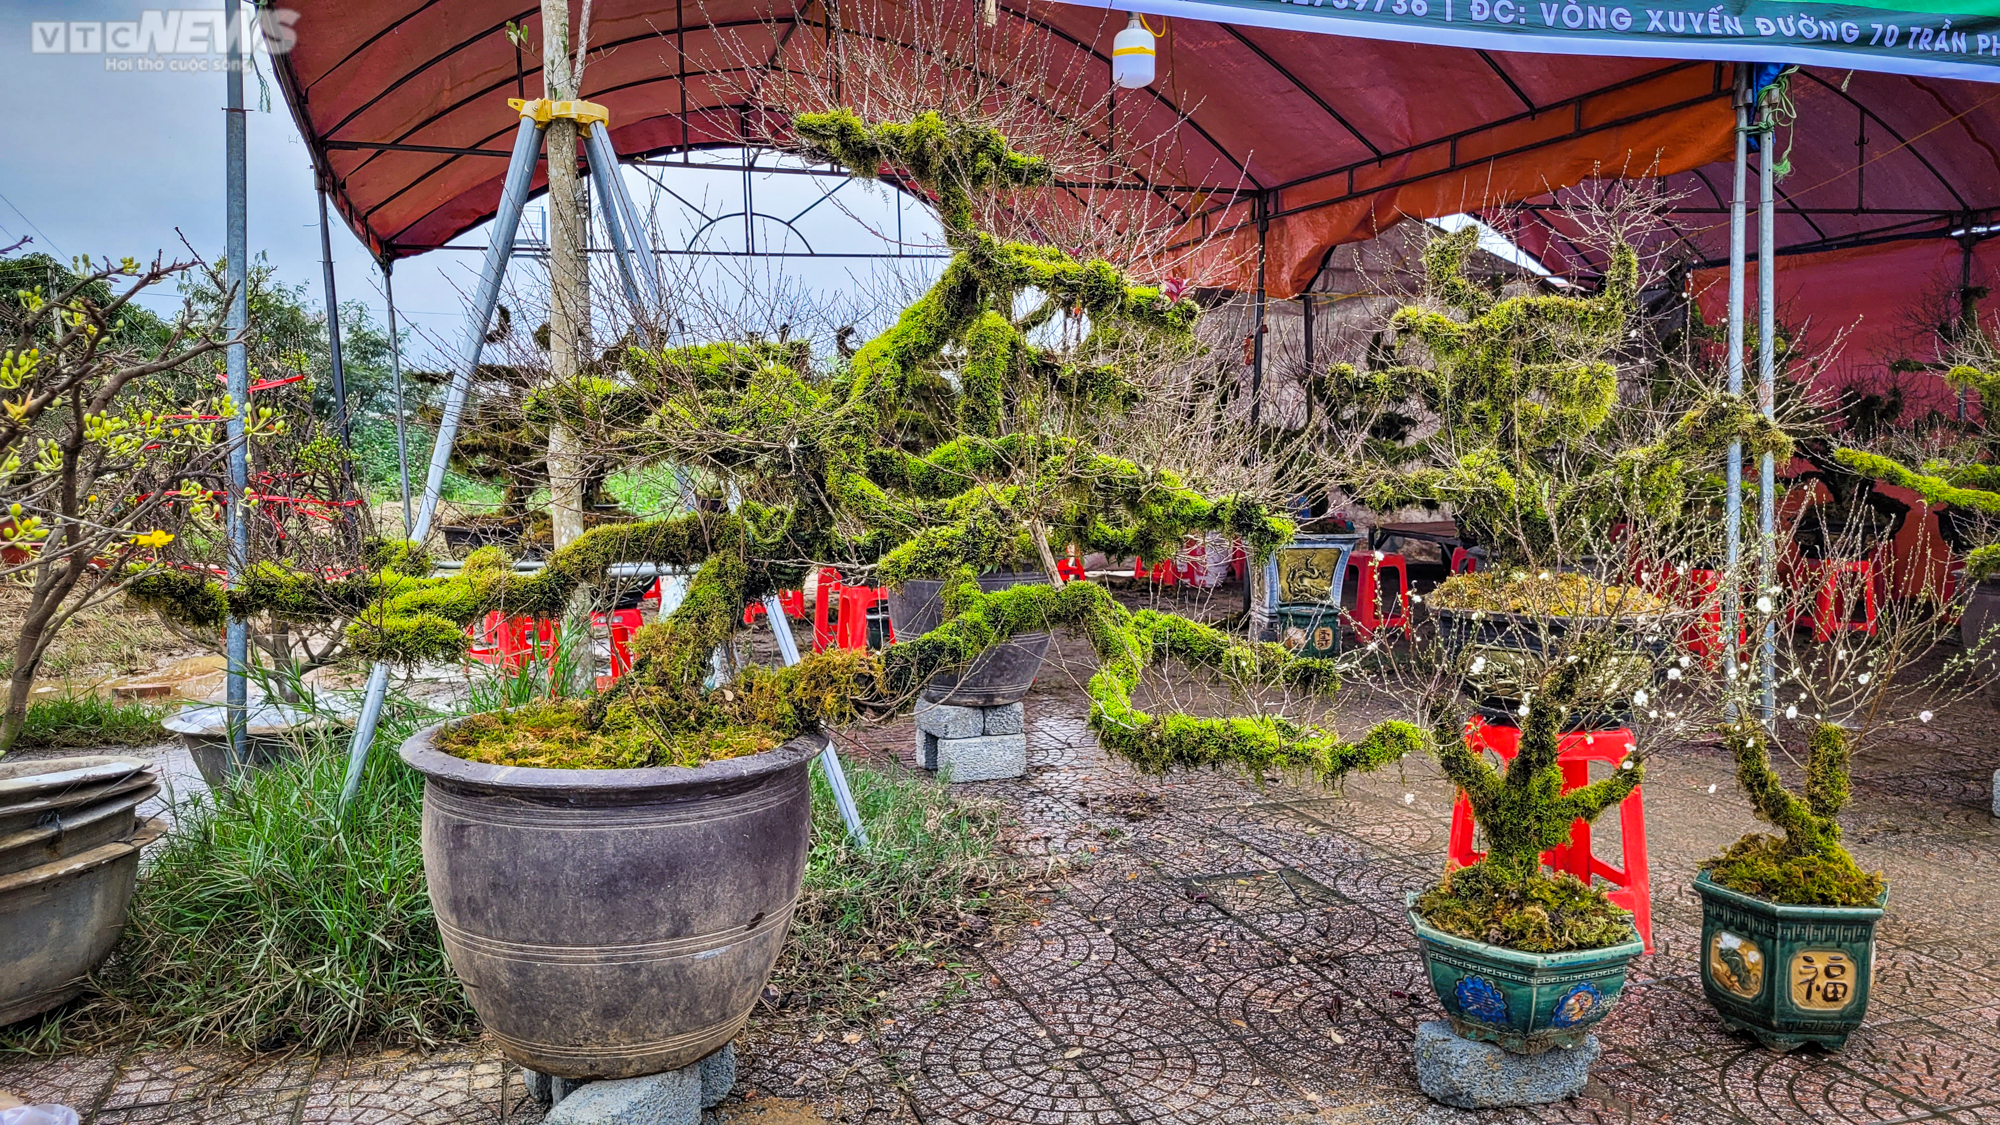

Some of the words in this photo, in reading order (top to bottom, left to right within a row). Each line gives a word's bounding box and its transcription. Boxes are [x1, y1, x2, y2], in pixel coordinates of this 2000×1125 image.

[1469, 0, 1527, 25] ĐC:
[1540, 0, 1633, 31] VÒNG
[1645, 4, 1745, 36] XUYẾN
[1755, 13, 1860, 44] ĐƯỜNG
[1869, 23, 1900, 48] 70
[1908, 18, 1967, 54] TRẦN
[1798, 955, 1849, 1003] 福
